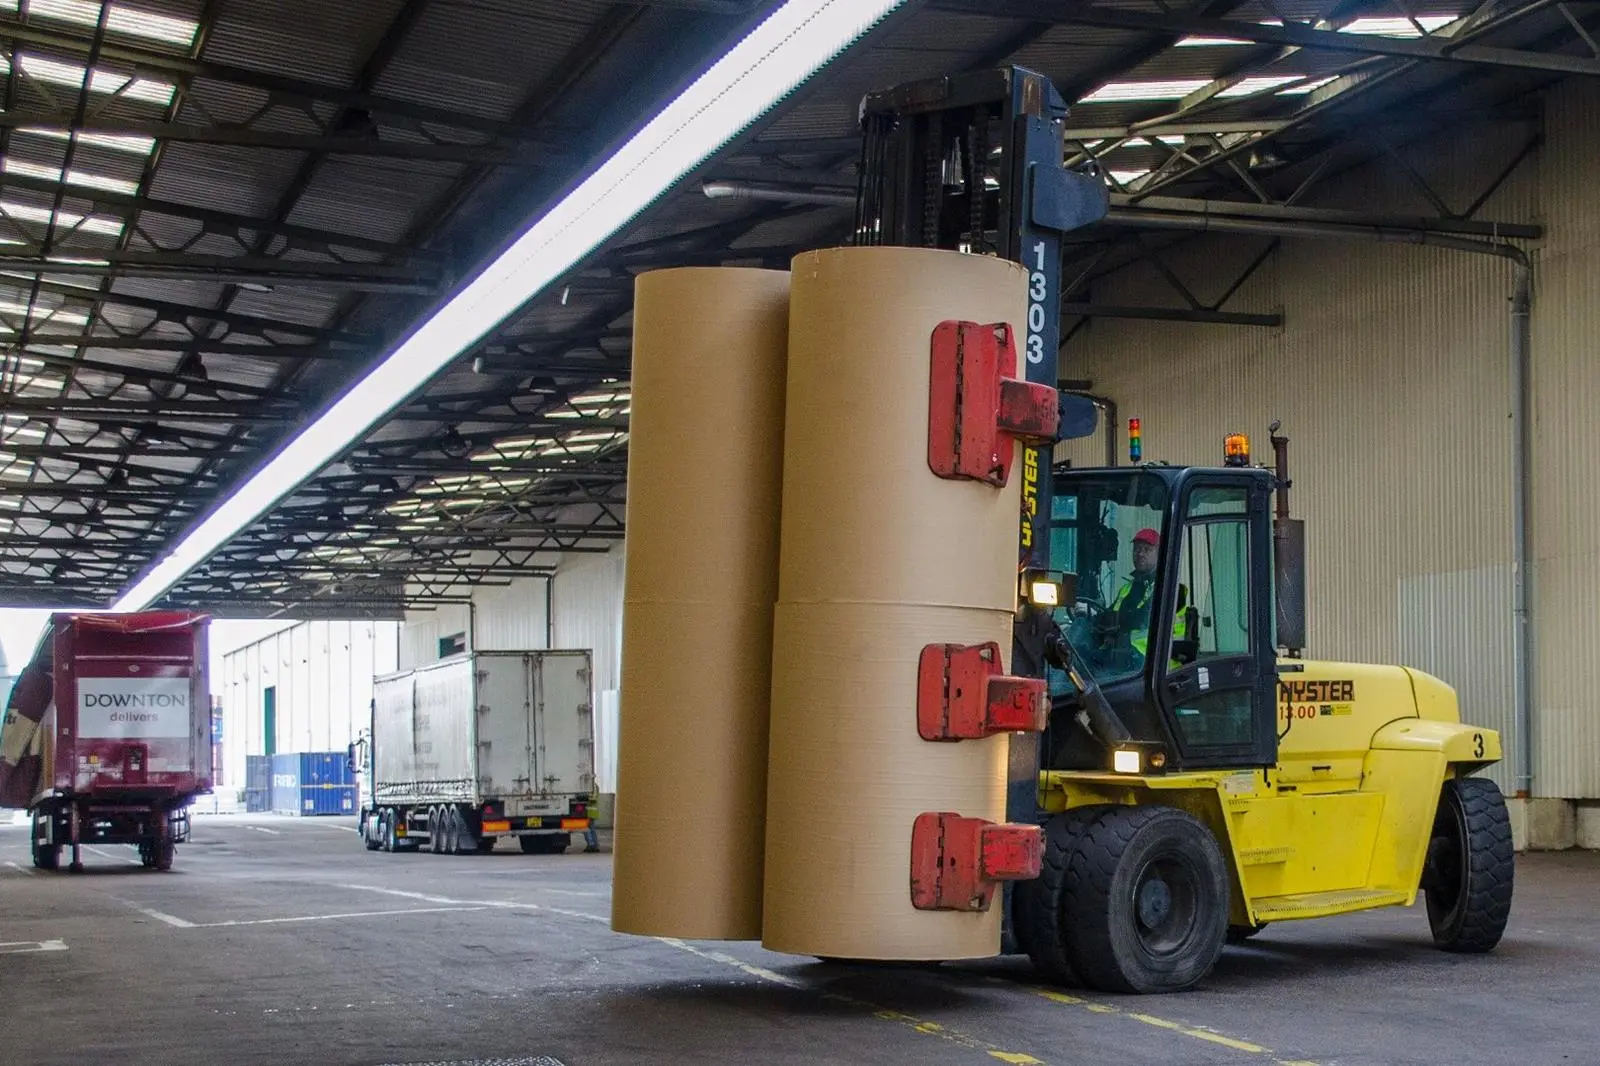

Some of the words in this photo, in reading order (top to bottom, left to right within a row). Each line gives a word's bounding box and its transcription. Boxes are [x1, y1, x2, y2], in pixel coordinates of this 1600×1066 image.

[1027, 241, 1047, 364] 1303
[85, 694, 185, 707] DOWNTON
[110, 712, 158, 722] delivers
[1473, 733, 1484, 758] 3
